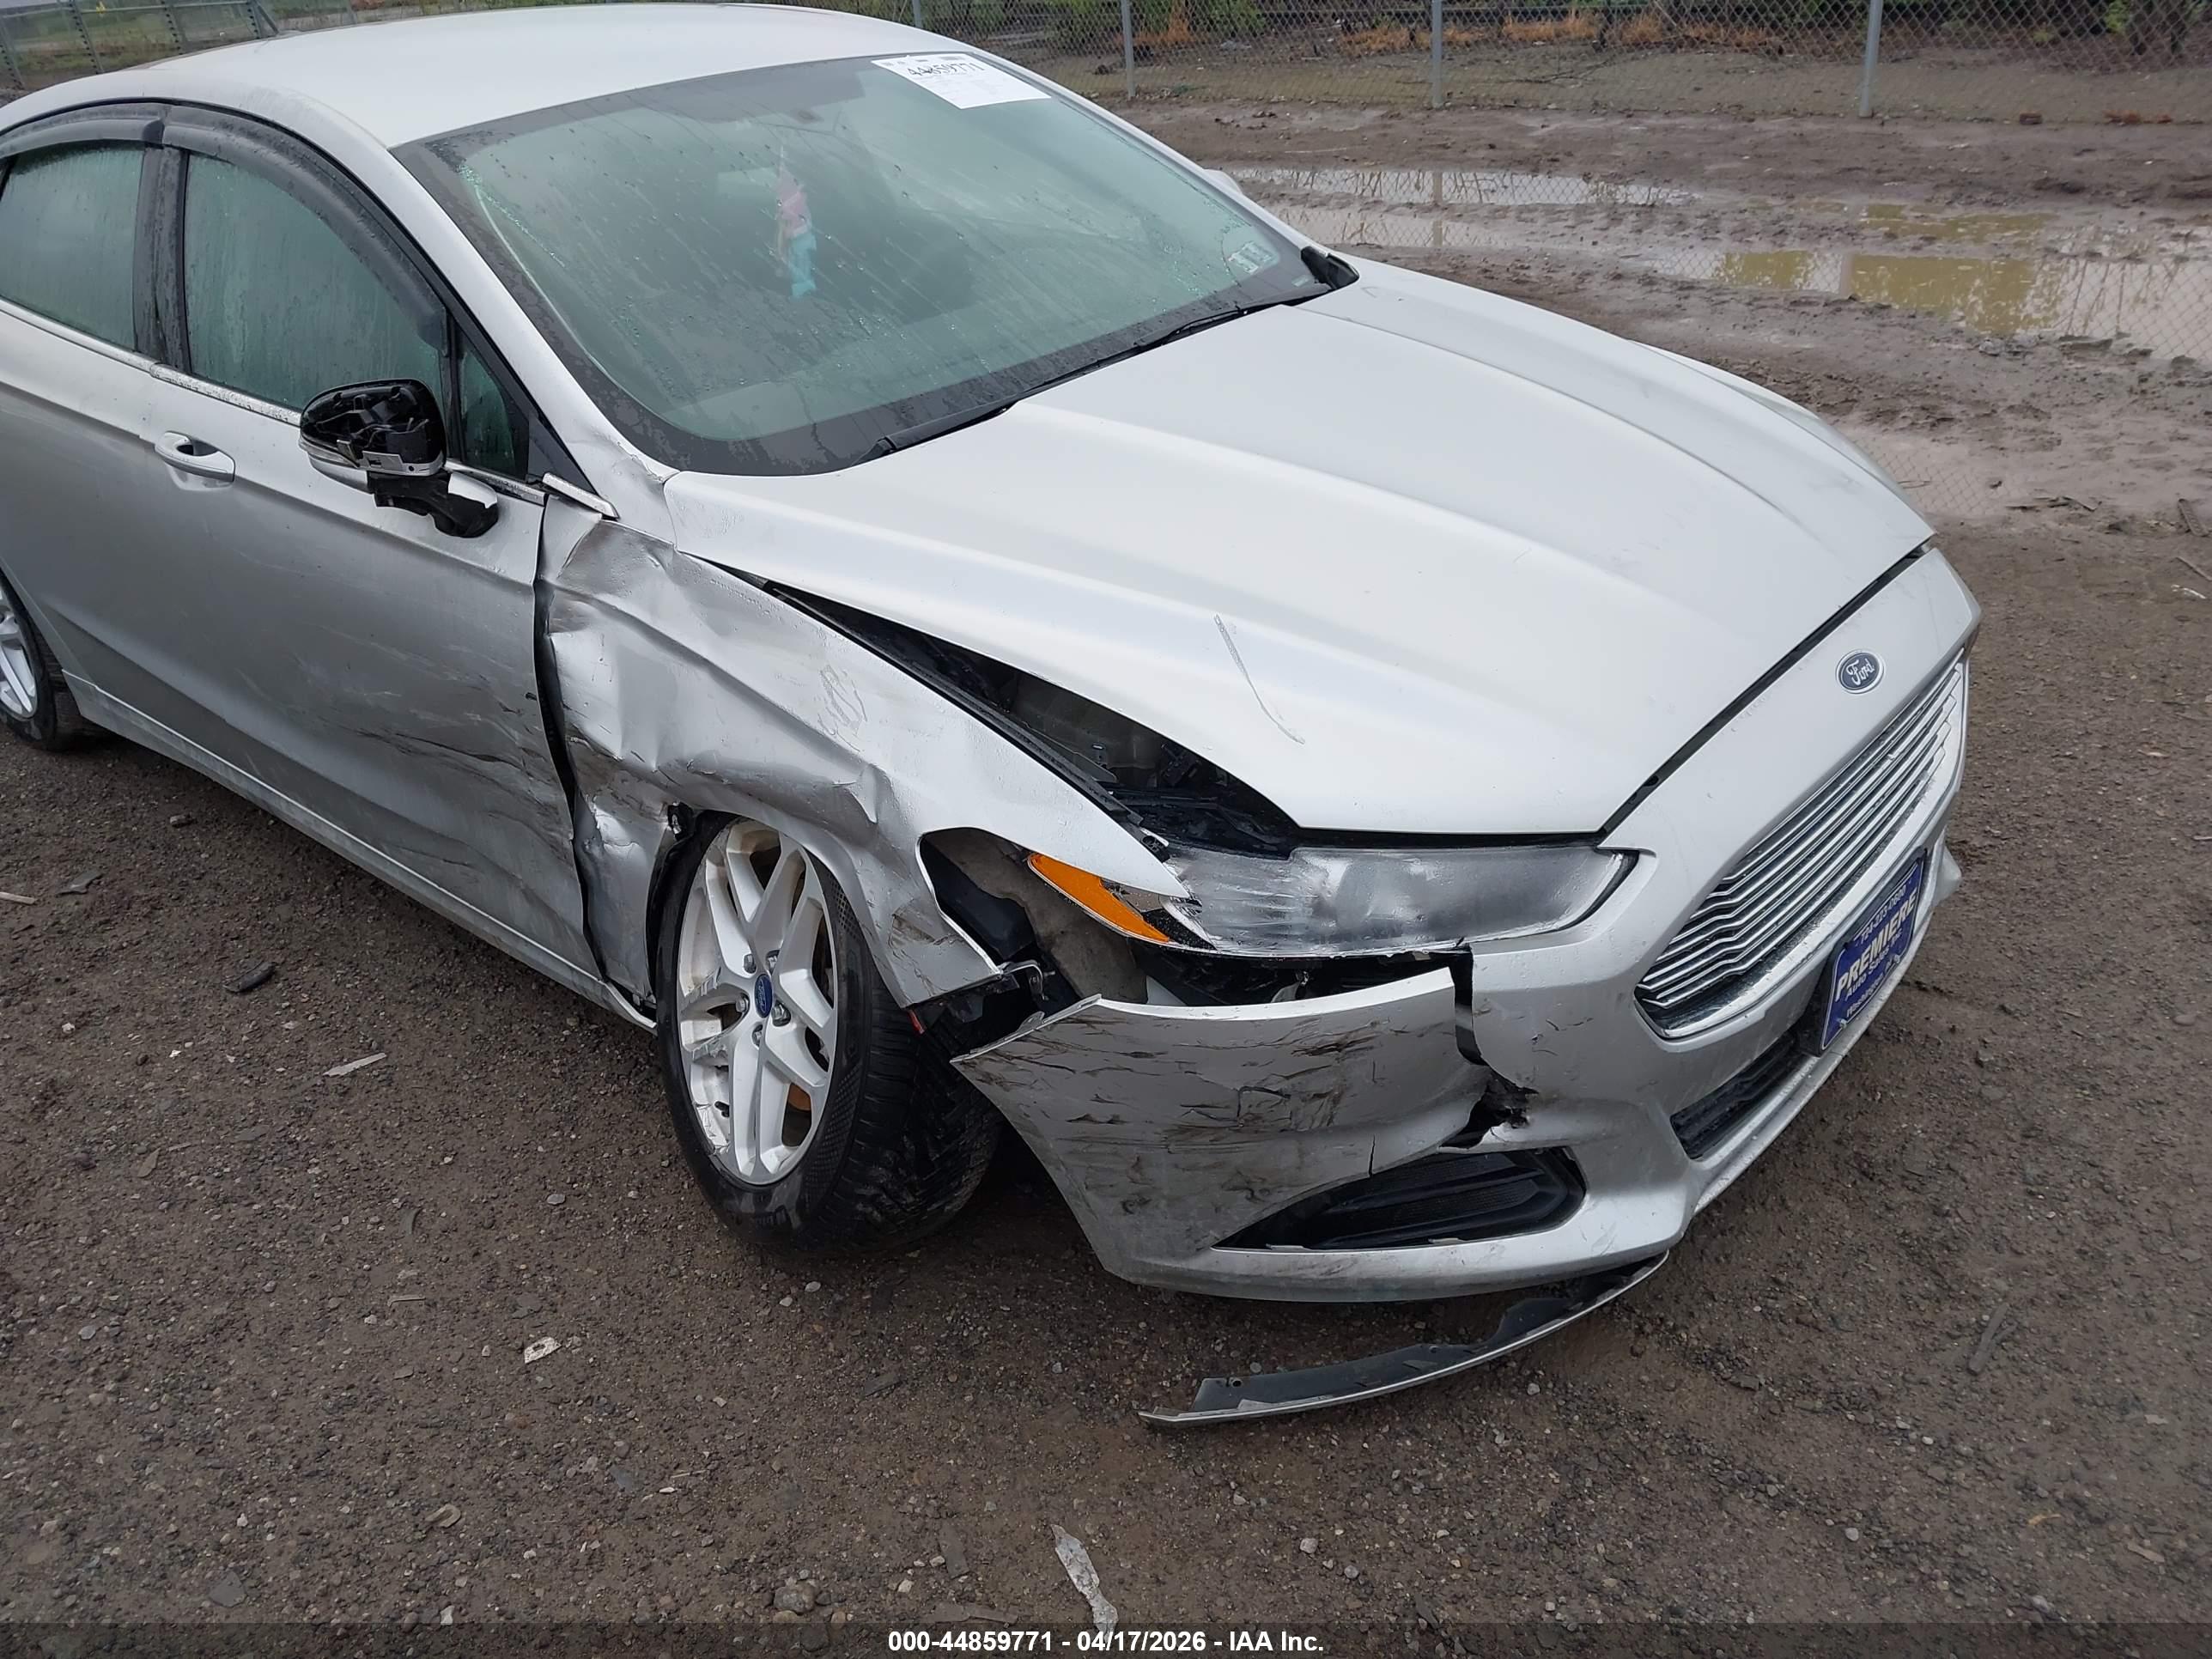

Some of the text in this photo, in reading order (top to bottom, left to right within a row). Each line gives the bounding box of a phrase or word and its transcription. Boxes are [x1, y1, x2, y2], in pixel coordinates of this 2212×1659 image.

[1846, 658, 1875, 686] Ford
[1835, 887, 1917, 1002] PREMIERE
[1844, 973, 1867, 1002] Auto
[1869, 945, 1890, 975] Sales
